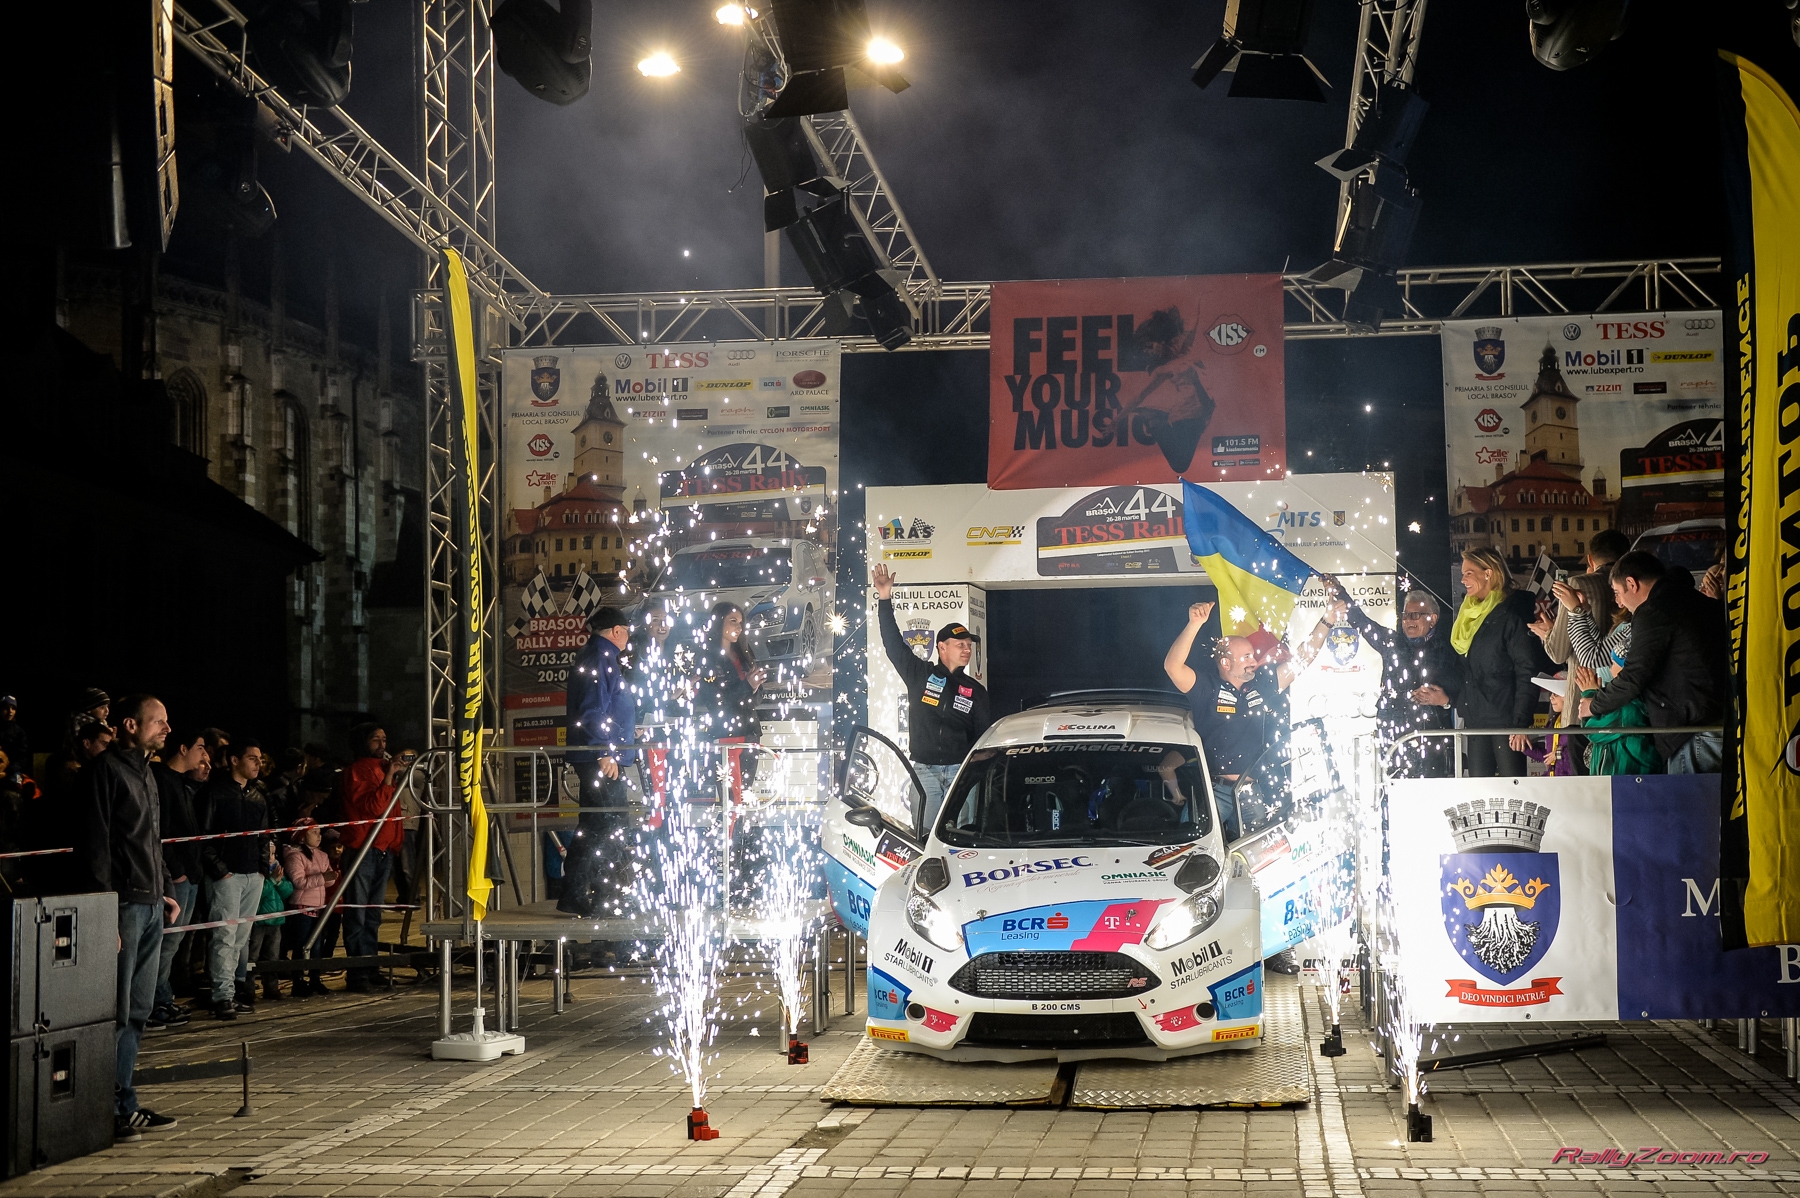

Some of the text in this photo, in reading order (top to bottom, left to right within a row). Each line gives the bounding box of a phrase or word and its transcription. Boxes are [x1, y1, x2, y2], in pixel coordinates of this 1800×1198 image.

[1208, 322, 1250, 346] KISS
[1596, 320, 1666, 340] TESS
[1013, 314, 1150, 375] FEEL
[646, 351, 710, 369] TESS
[776, 350, 830, 358] PORSCHE
[1565, 350, 1621, 366] Mobil
[1566, 366, 1644, 376] www.lubexpert.ro
[615, 377, 667, 394] Mobil
[1004, 372, 1122, 412] YOUR
[1014, 408, 1157, 451] MUSIC
[1224, 438, 1246, 446] 101.5
[742, 446, 790, 474] 44
[1638, 453, 1707, 475] TESS
[677, 470, 810, 496] TESS Rally
[1124, 489, 1176, 520] 44
[1277, 511, 1321, 528] MTS
[1054, 516, 1184, 546] TESS Rall
[872, 589, 962, 600] CNSILIUL LOCAL
[1352, 586, 1389, 596] LOCAL
[921, 600, 964, 610] BRASOV
[530, 618, 586, 632] BRASOV
[516, 634, 591, 650] RALLY SHO
[521, 652, 578, 667] 27.03.20
[538, 670, 570, 682] 20:0
[842, 833, 876, 868] OMNIASIG
[962, 856, 1093, 888] BORSEC
[1100, 871, 1166, 880] OMNIASIG
[848, 888, 870, 922] BCR
[1002, 917, 1045, 932] BCR
[1283, 921, 1312, 943] easing
[1001, 932, 1040, 941] Leasing
[894, 938, 922, 966] Mobil
[884, 952, 934, 987] STARLUBRICANTS
[1170, 949, 1209, 977] Mobil
[1170, 956, 1233, 990] STARLUBRICANTS
[1224, 985, 1246, 1002] BCR
[1461, 990, 1481, 1002] DEO
[1482, 994, 1514, 1003] VINDICI
[1224, 999, 1244, 1010] Leasing
[872, 1028, 907, 1041] PIRELLI
[1216, 1026, 1256, 1040] PIRELLI
